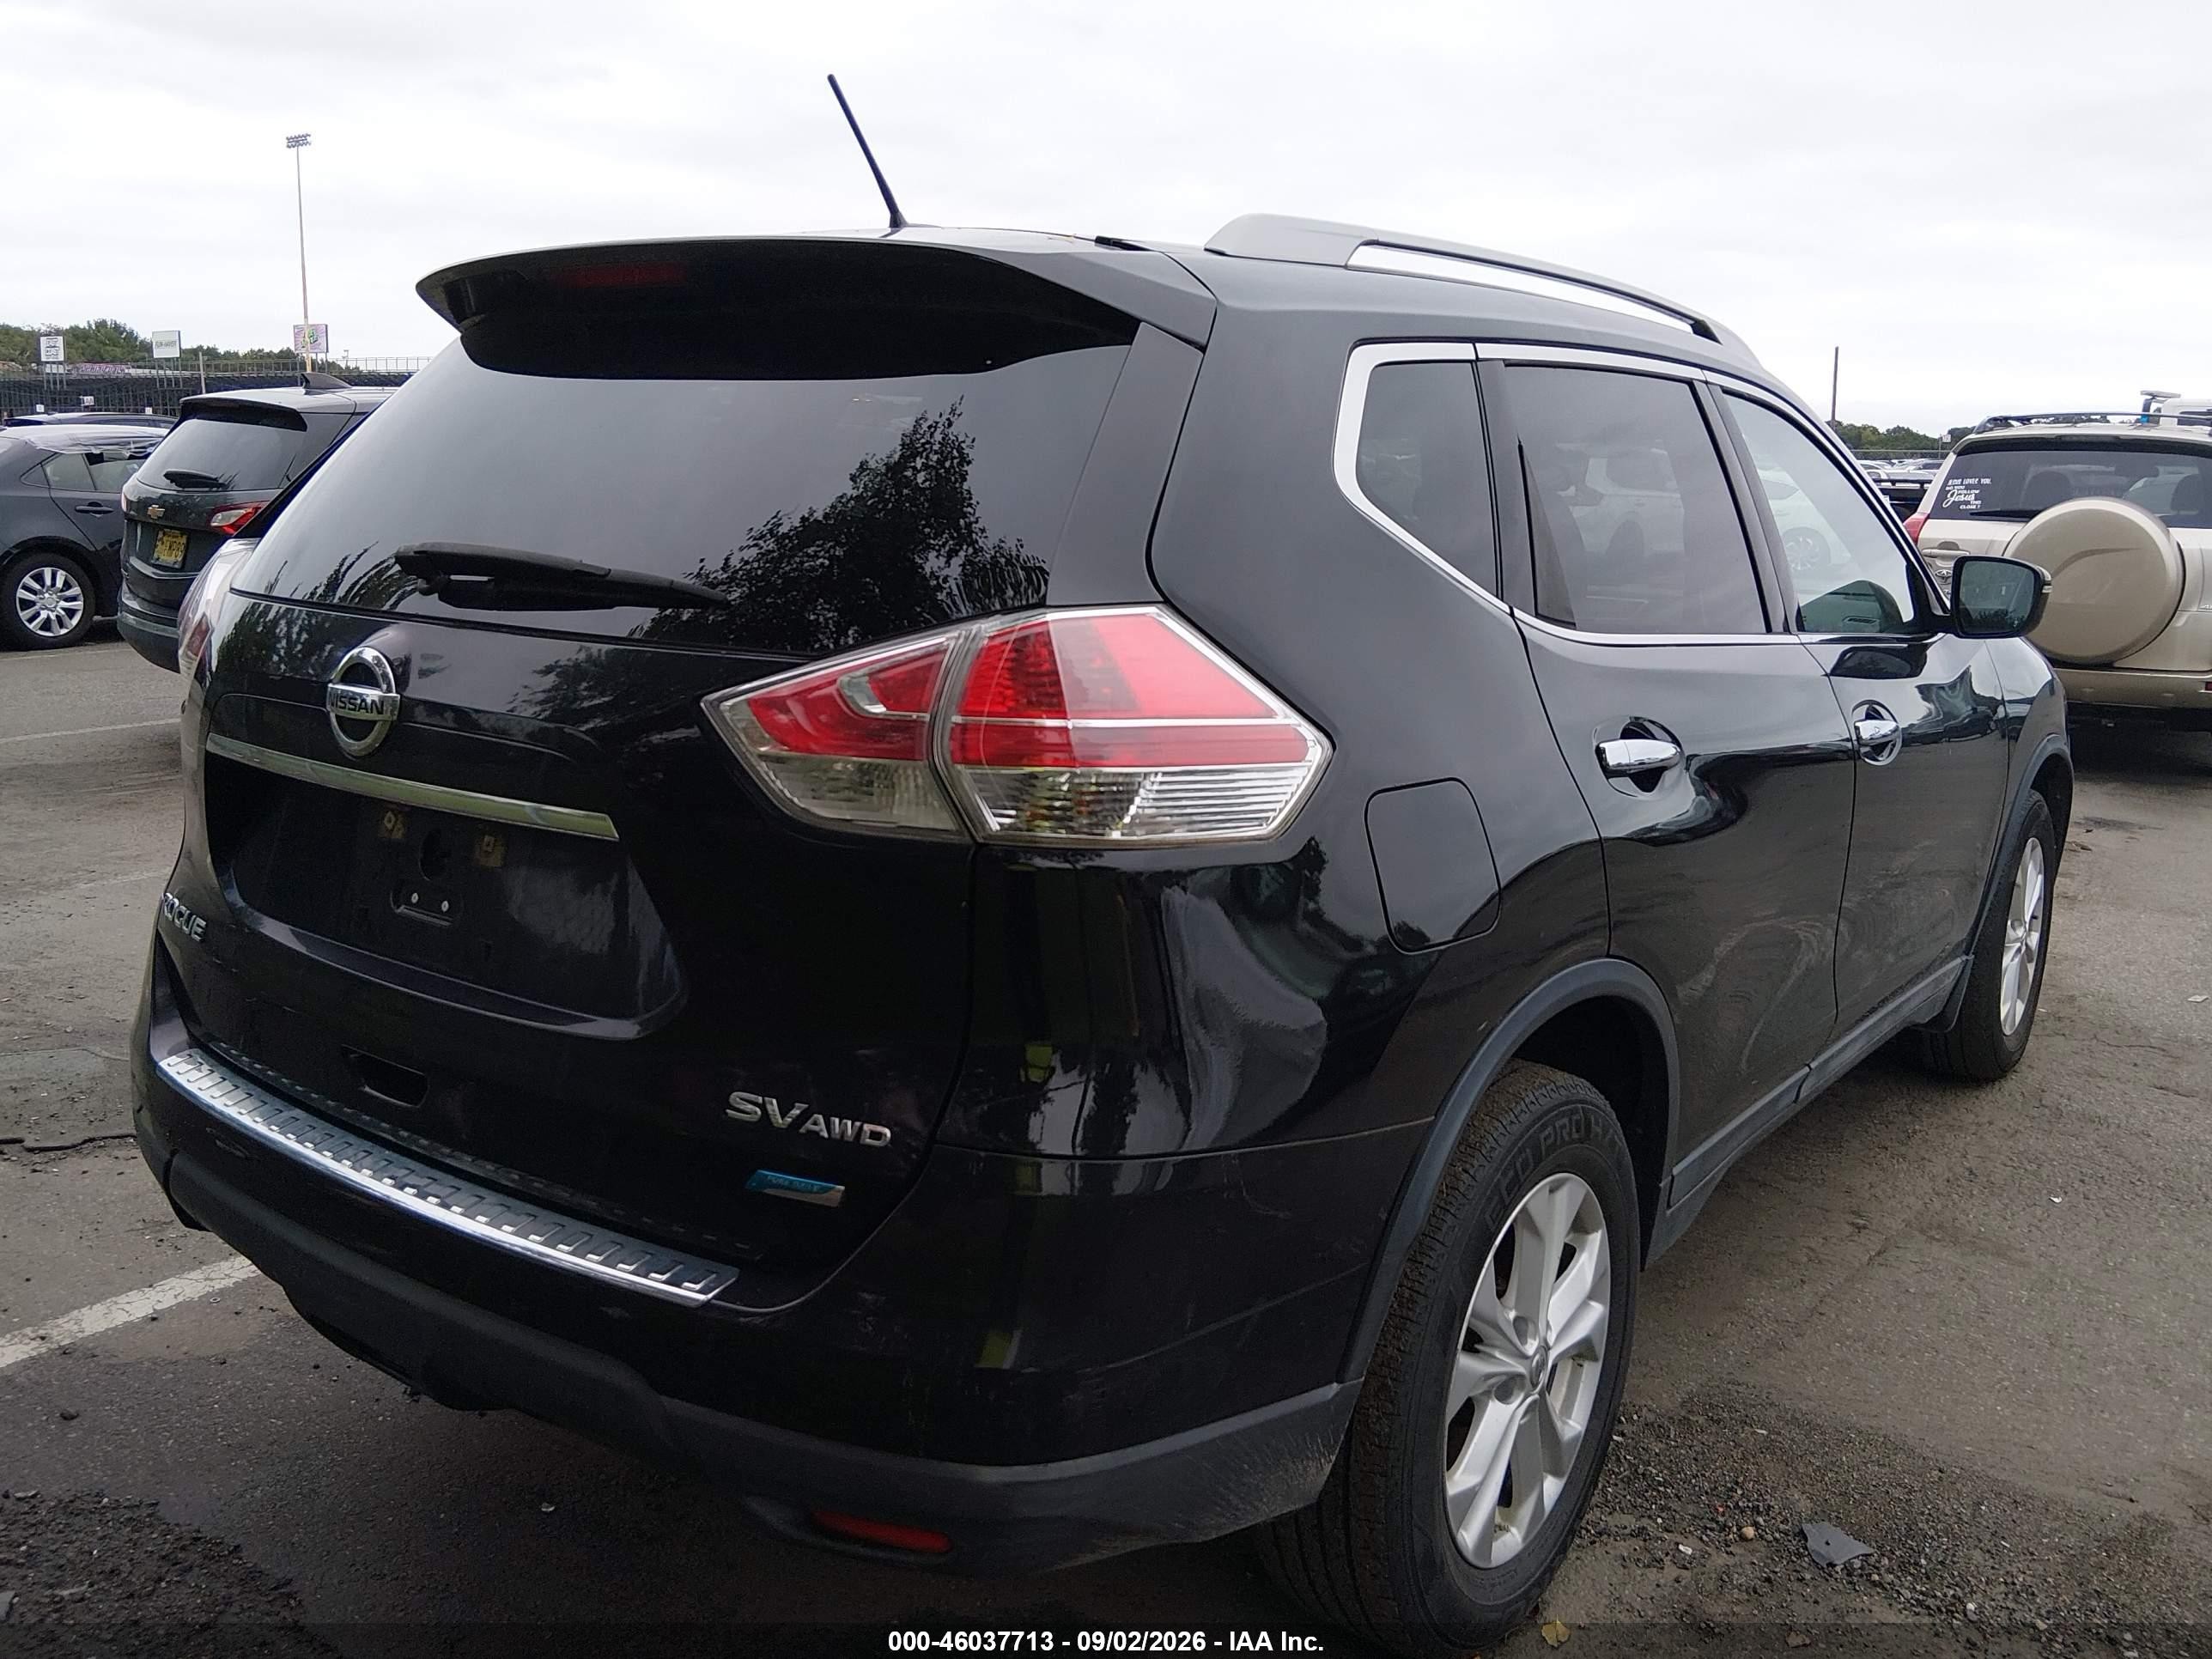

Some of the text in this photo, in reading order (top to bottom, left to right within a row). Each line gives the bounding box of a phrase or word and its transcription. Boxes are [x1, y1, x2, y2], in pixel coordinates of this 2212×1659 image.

[1942, 489, 1976, 508] Jesus
[328, 690, 385, 715] NISSAN
[725, 1091, 891, 1147] SV AWD
